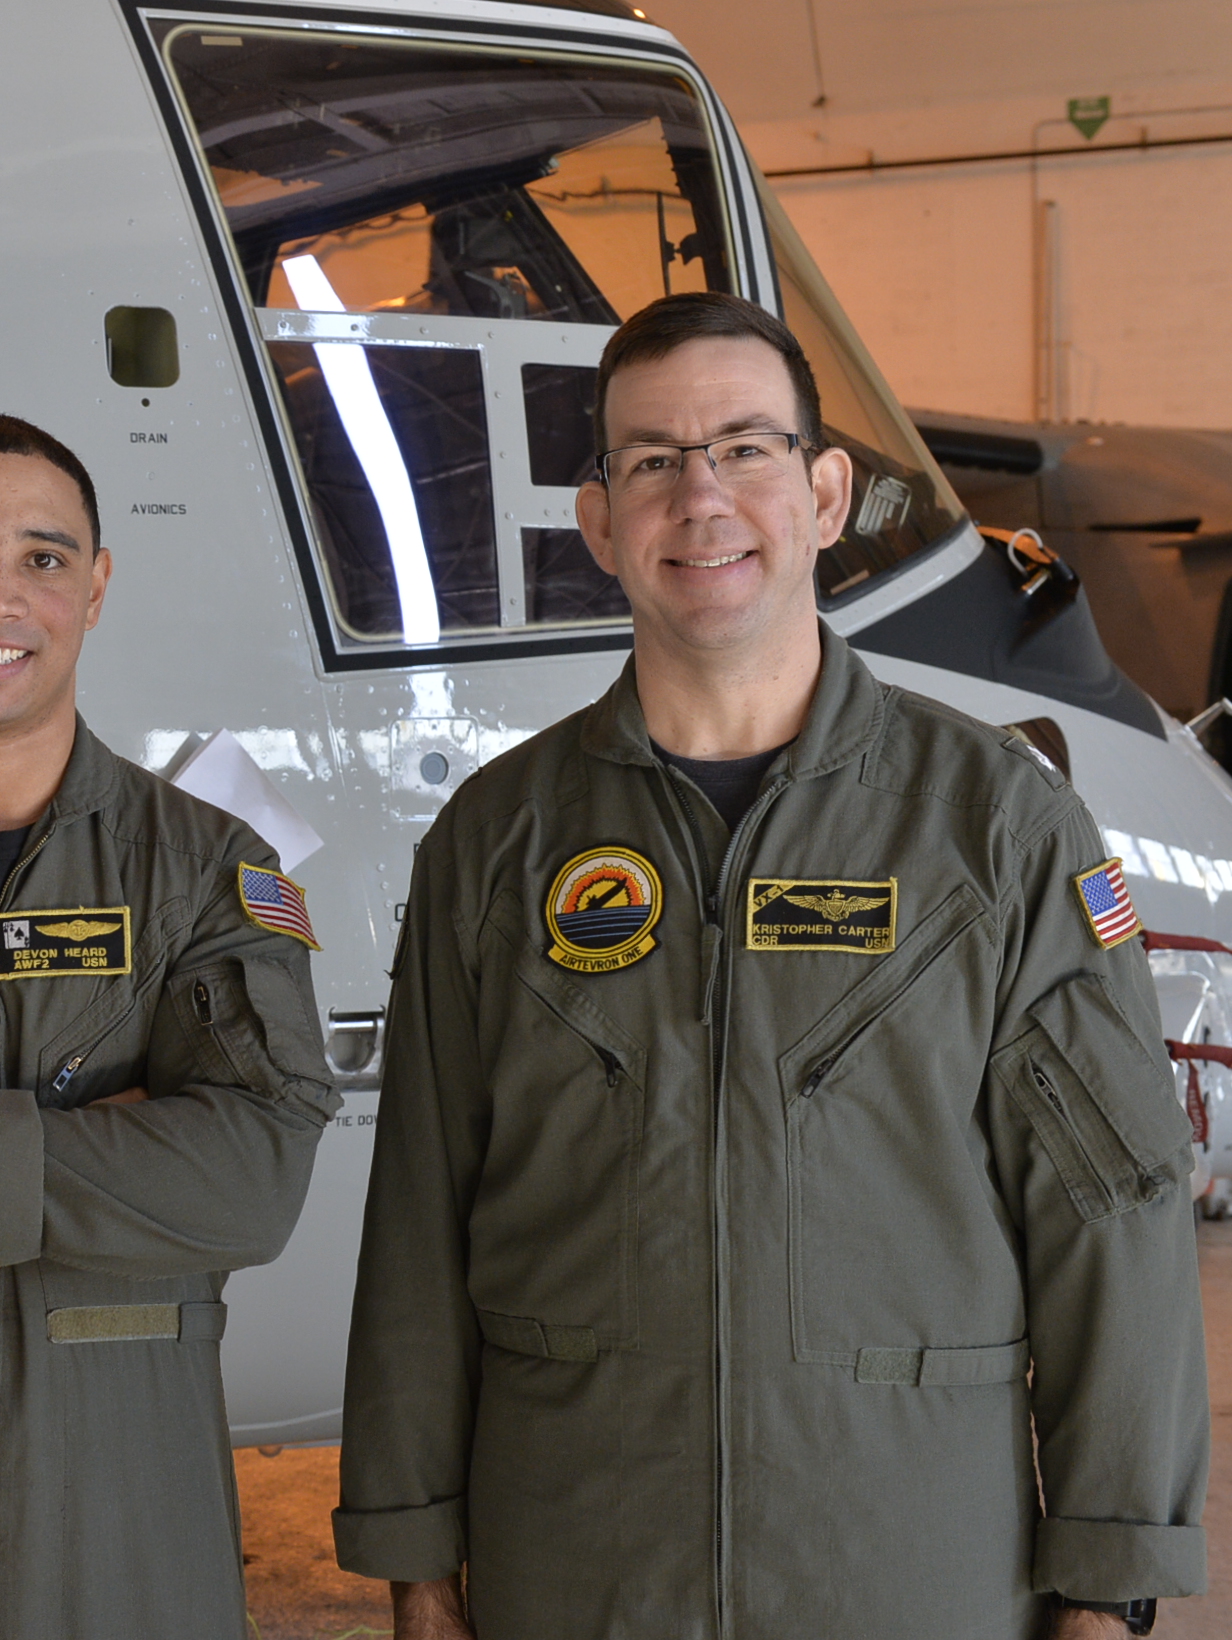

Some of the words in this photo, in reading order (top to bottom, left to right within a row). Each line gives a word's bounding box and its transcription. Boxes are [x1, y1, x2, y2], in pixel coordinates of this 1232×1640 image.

[130, 432, 168, 444] DRAIN
[130, 504, 187, 515] AVIONICS
[753, 886, 784, 908] VX-1
[752, 924, 833, 935] KRISTOPHER
[838, 925, 890, 938] CARTER
[752, 936, 779, 946] CDR
[864, 938, 890, 949] USN
[13, 948, 58, 960] DEVON
[64, 946, 108, 958] HEARD
[559, 954, 620, 971] AIRTEVRON
[622, 946, 644, 964] ONE
[14, 960, 50, 970] AWF2
[82, 957, 108, 968] USN
[336, 1116, 352, 1127] TIE
